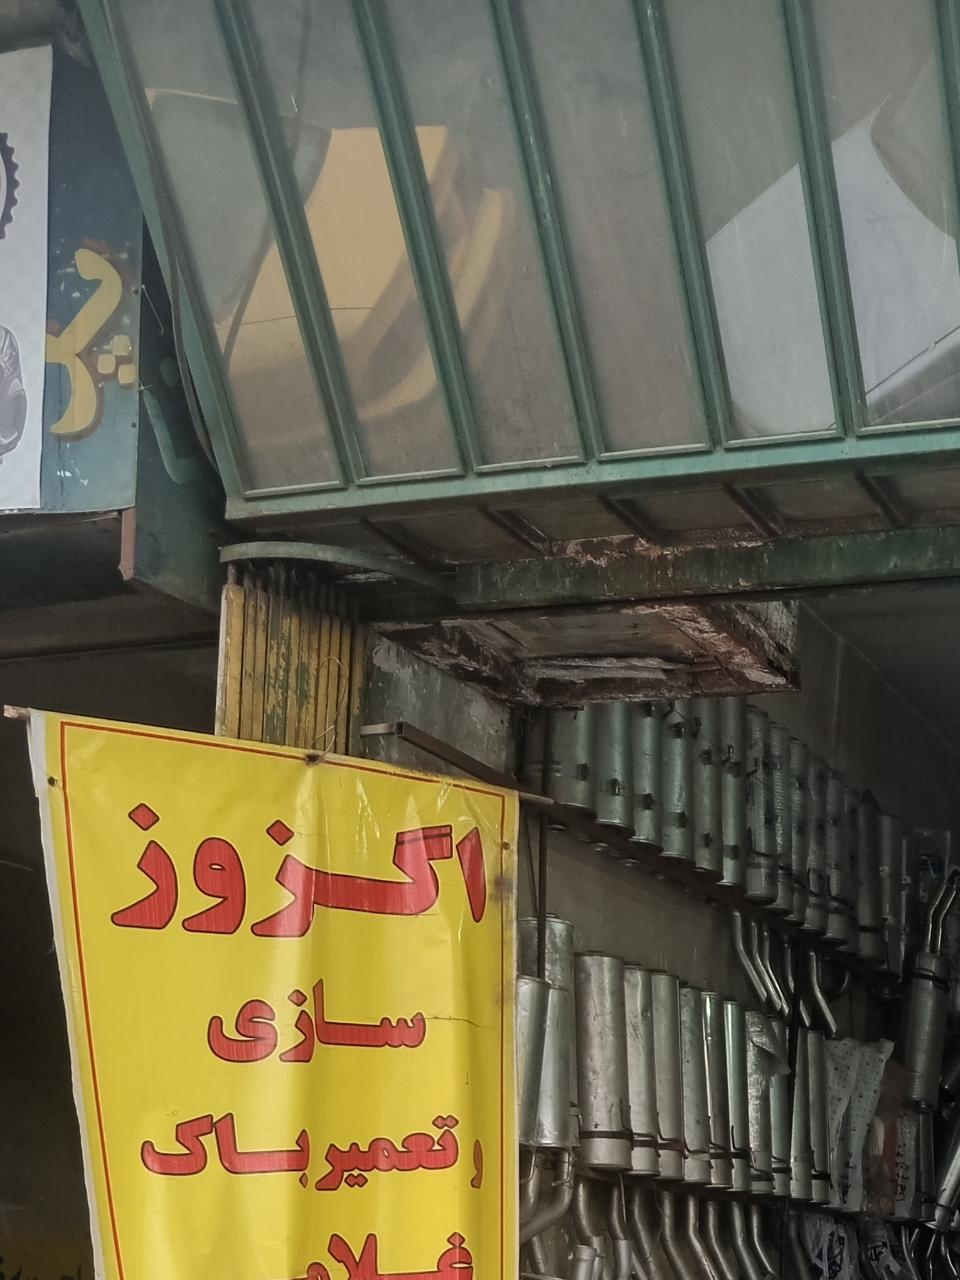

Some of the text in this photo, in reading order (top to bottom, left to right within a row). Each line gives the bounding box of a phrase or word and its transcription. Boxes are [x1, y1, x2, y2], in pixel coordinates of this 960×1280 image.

[110, 803, 487, 937] اگزوز
[206, 978, 427, 1063] سازی
[140, 1113, 311, 1187] باک
[315, 1114, 459, 1192] تعمیر
